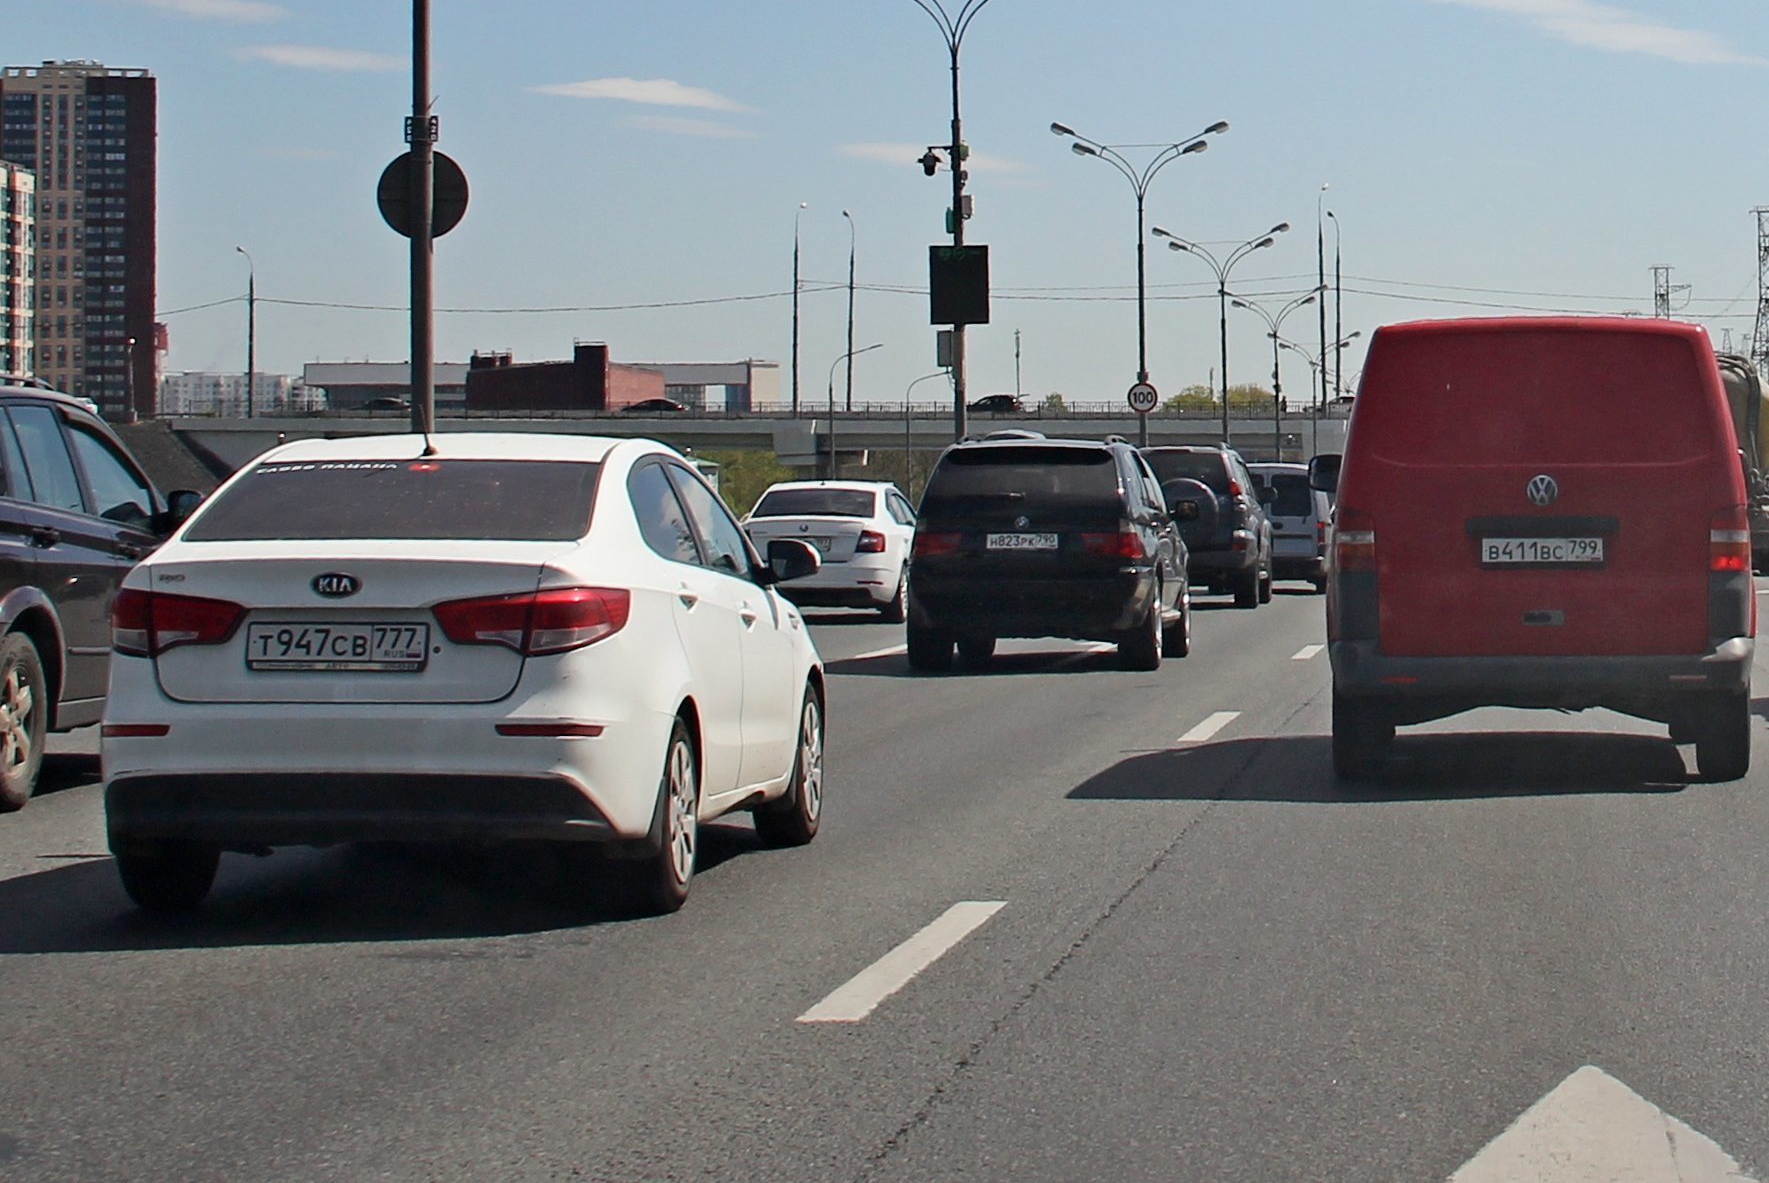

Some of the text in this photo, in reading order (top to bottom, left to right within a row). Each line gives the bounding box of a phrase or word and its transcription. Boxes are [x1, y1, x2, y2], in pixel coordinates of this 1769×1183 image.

[1132, 391, 1153, 404] 100
[1489, 540, 1598, 560] В411ВС 799
[318, 577, 353, 593] KIA
[259, 627, 418, 657] Т947СВ 777
[384, 650, 406, 658] RUS
